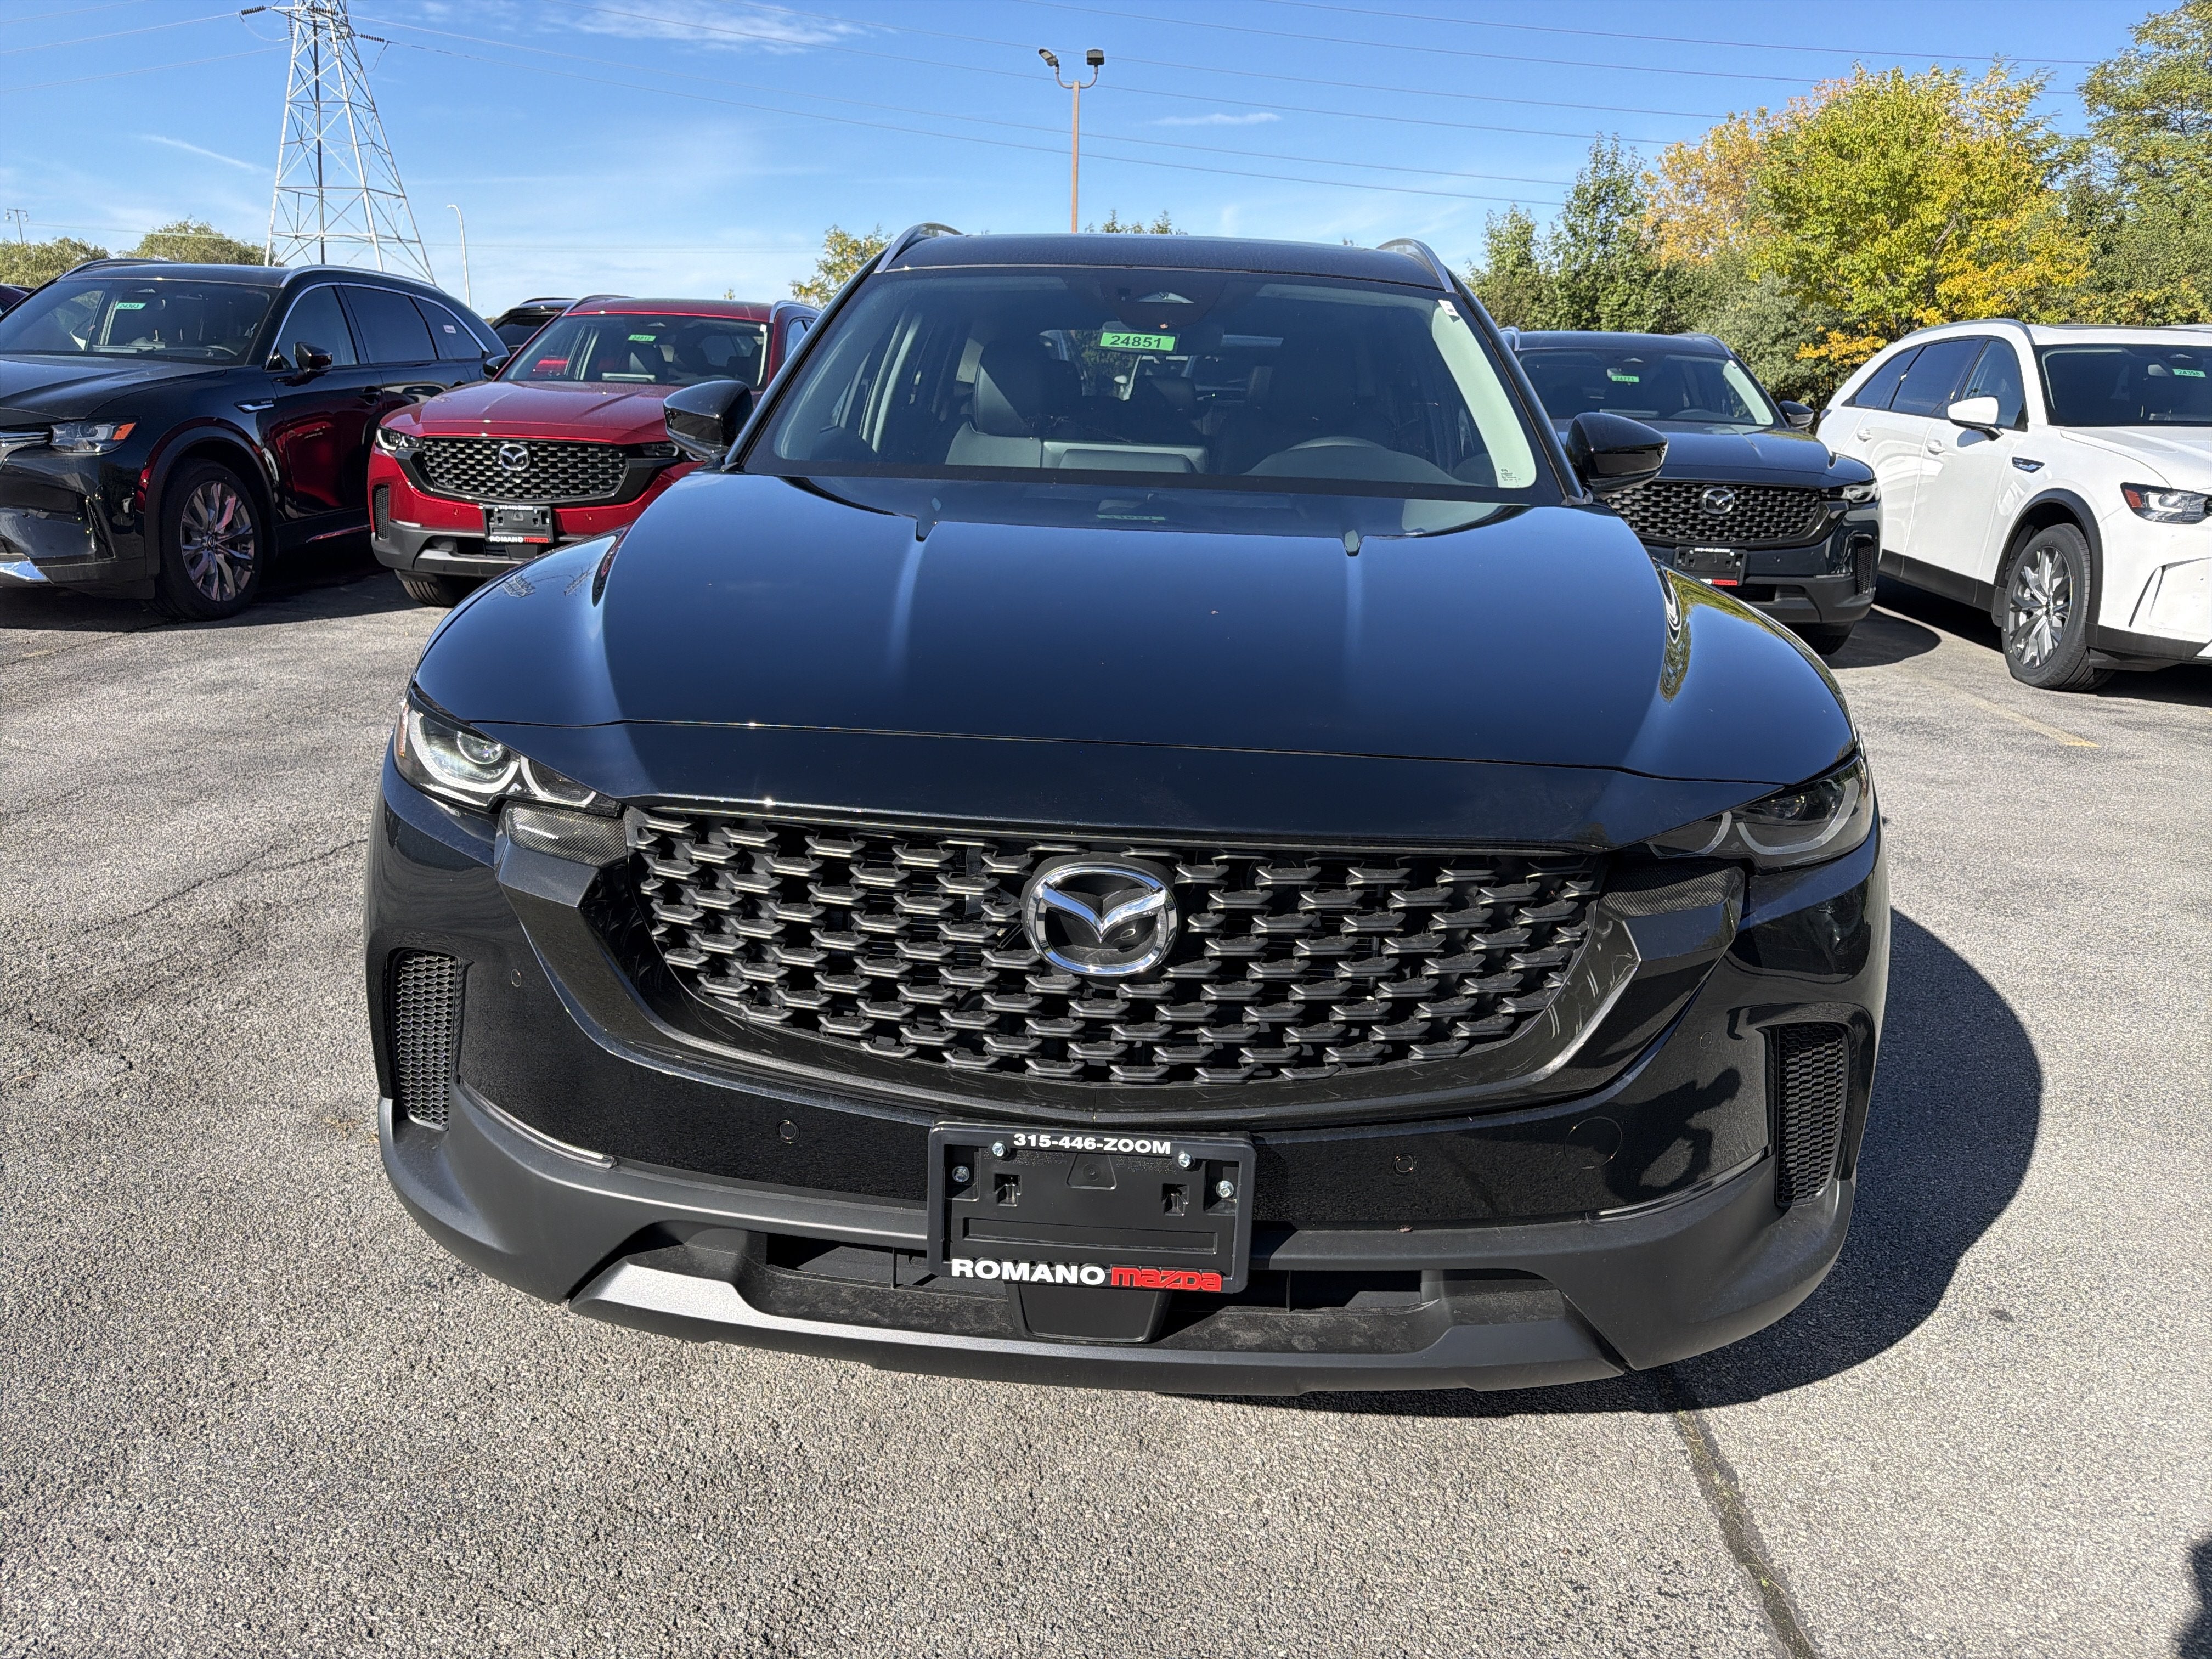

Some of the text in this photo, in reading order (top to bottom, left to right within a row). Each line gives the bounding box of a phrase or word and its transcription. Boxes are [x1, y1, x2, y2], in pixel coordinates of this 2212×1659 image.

[1109, 335, 1161, 348] 24851
[1014, 1133, 1171, 1154] 315-446-ZOOM
[952, 1259, 1222, 1291] ROMANO mazda
